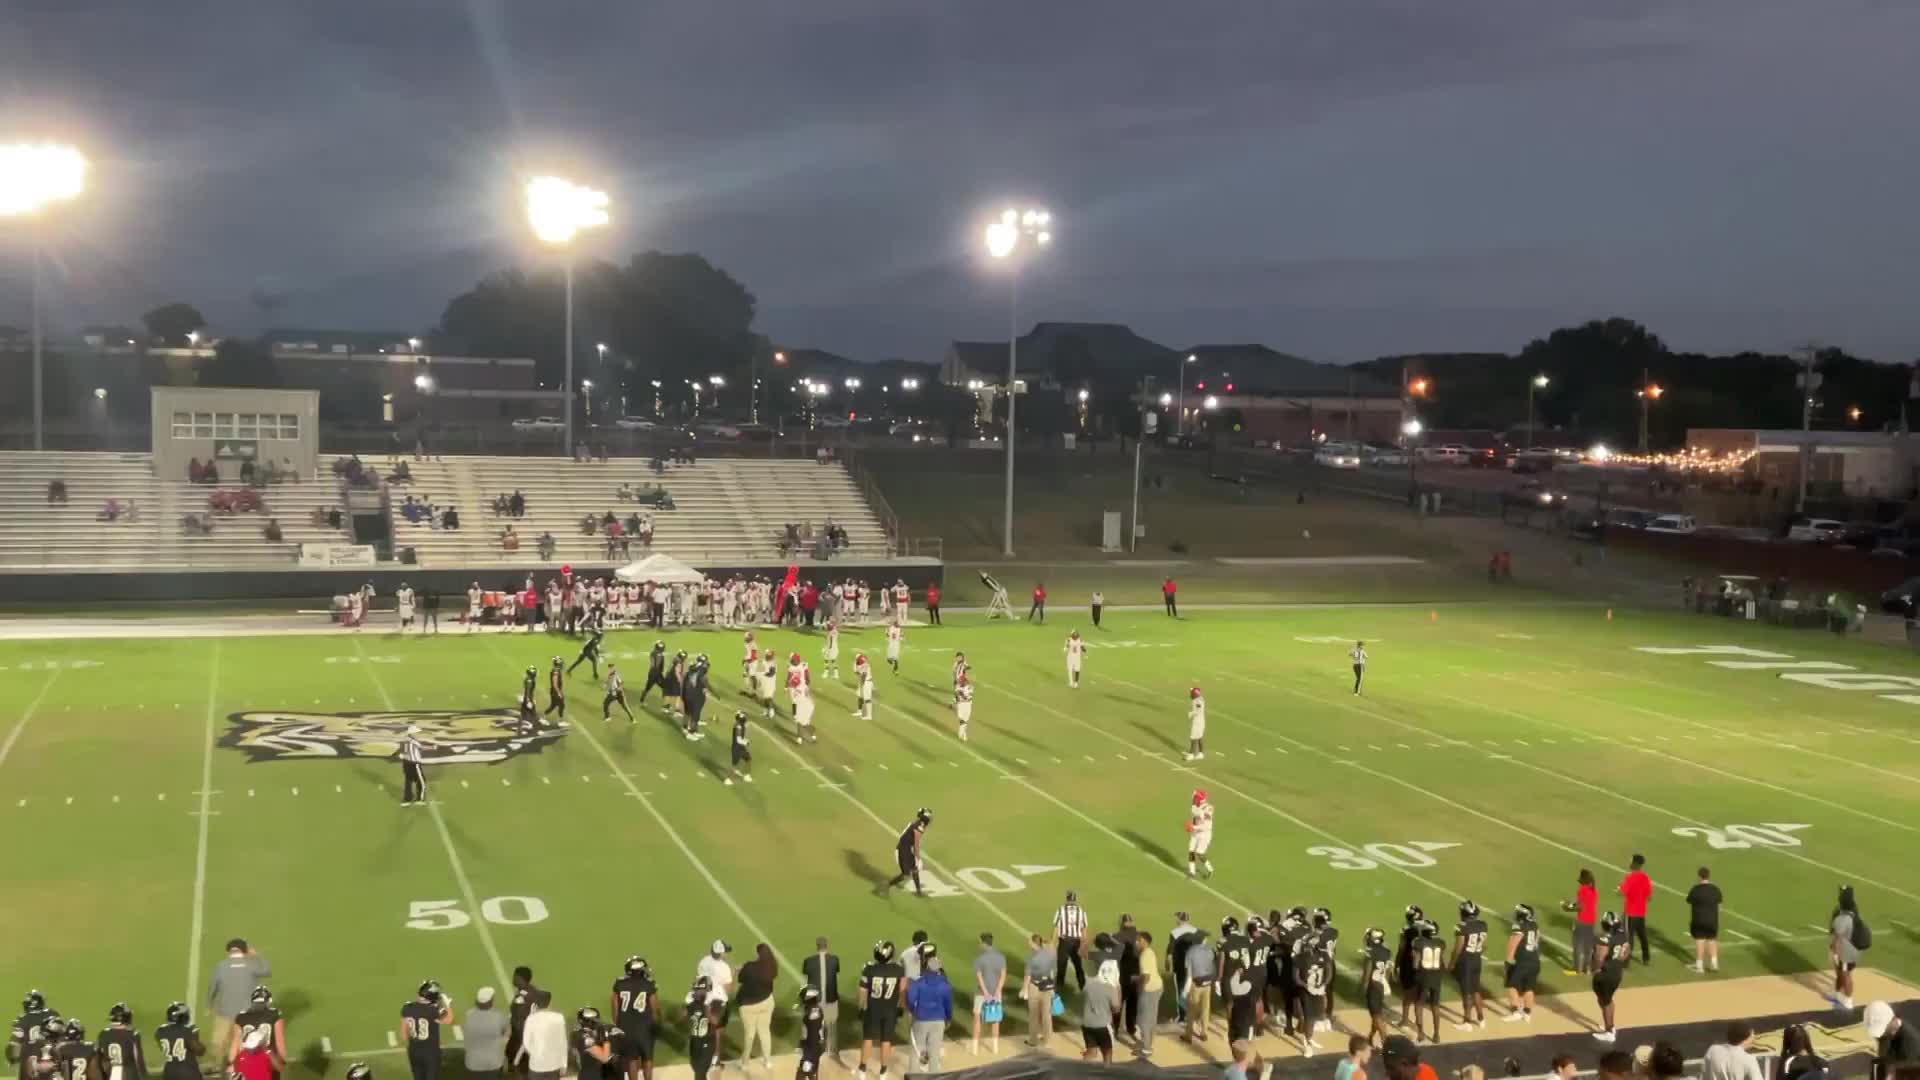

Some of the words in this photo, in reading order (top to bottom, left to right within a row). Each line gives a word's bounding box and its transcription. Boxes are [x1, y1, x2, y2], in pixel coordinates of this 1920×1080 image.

[1671, 824, 1802, 849] 20
[1306, 843, 1437, 870] 30
[903, 866, 1026, 897] 40
[405, 896, 549, 930] 50
[870, 976, 897, 1000] 57
[620, 991, 648, 1013] 74
[108, 1043, 123, 1065] 9
